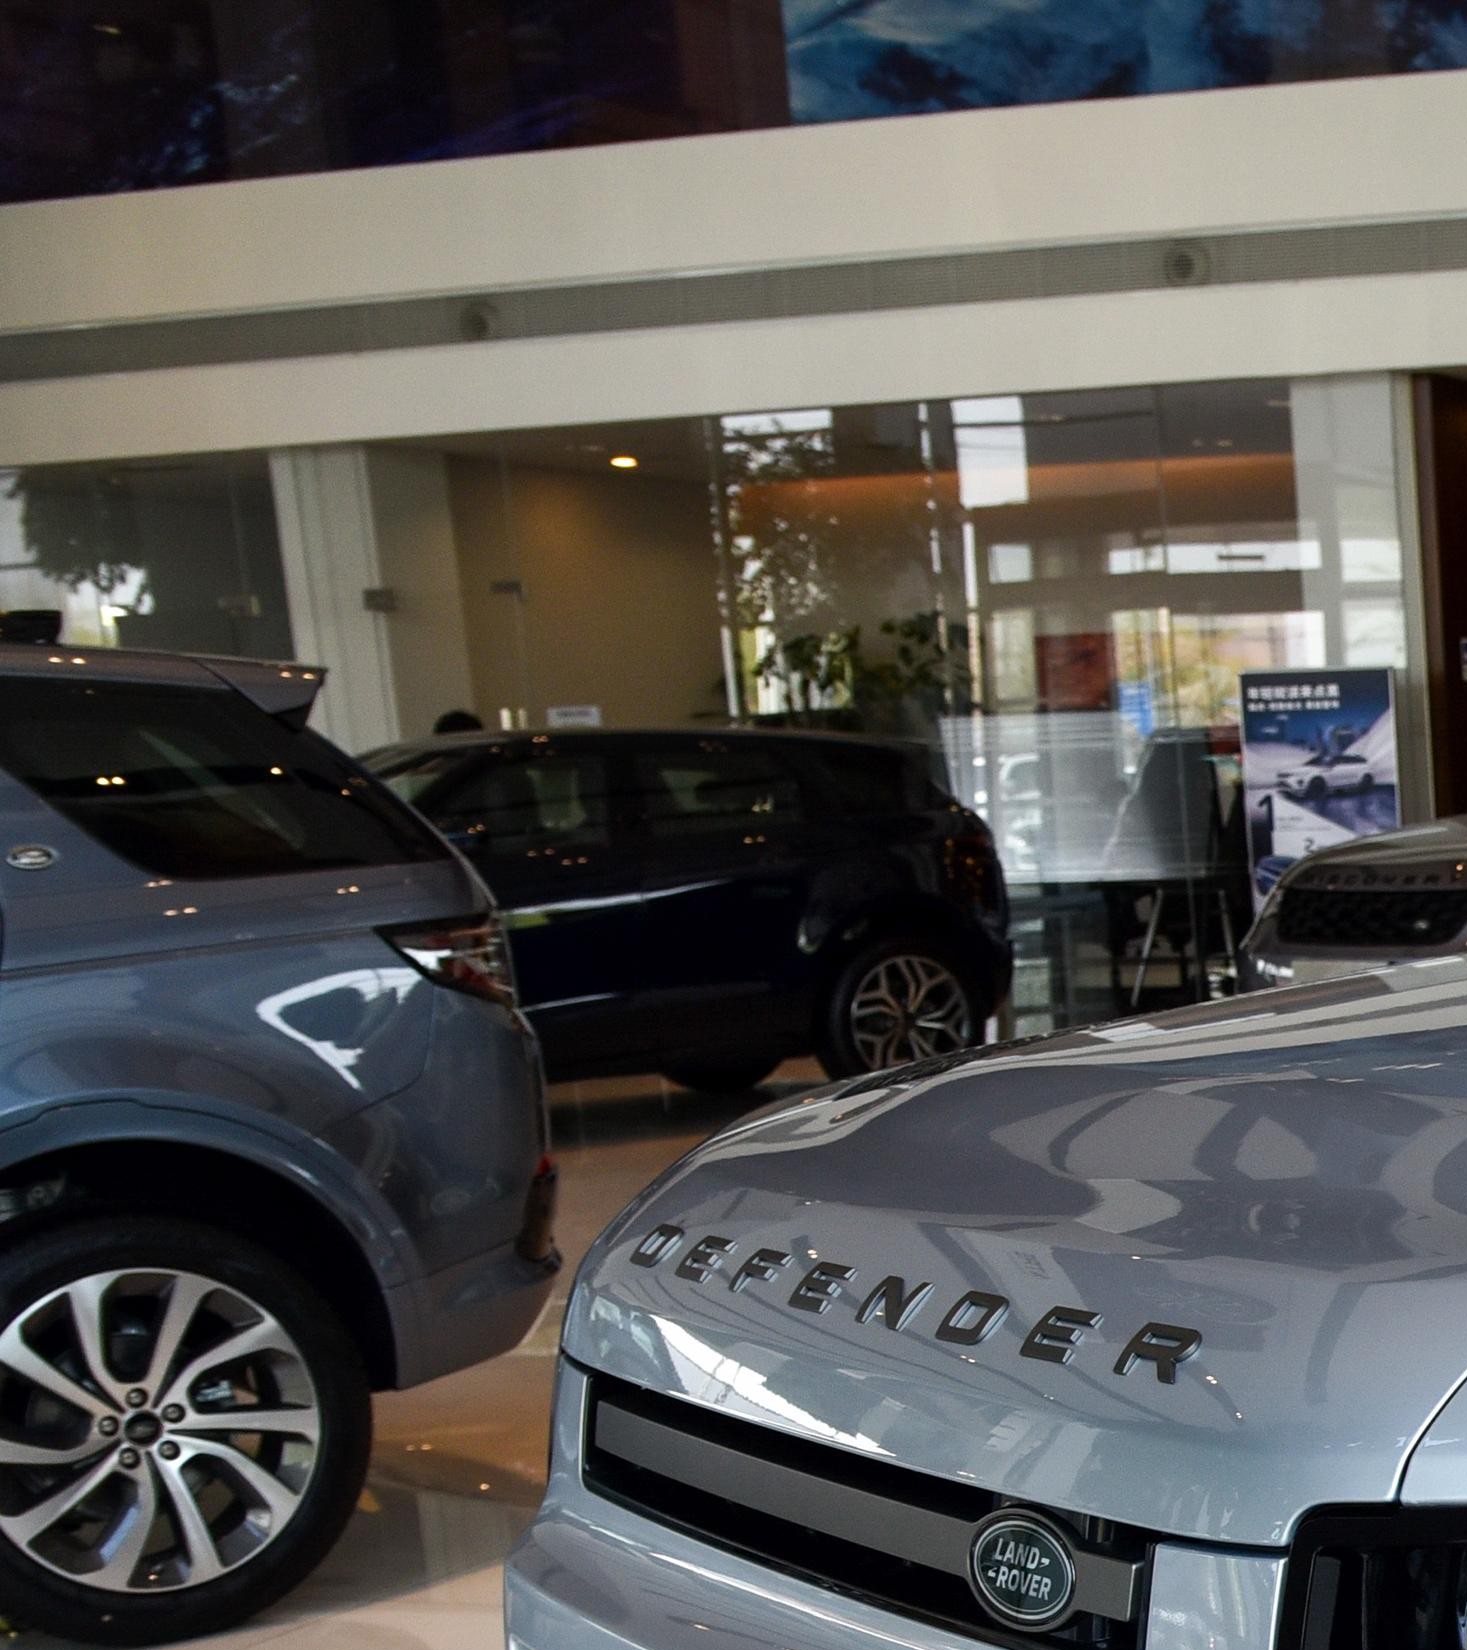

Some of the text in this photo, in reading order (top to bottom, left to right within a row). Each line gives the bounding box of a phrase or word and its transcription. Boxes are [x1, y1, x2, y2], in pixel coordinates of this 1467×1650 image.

[629, 1224, 1202, 1385] DEFENDER
[994, 1538, 1040, 1570] LAND
[995, 1565, 1052, 1601] ROVER
